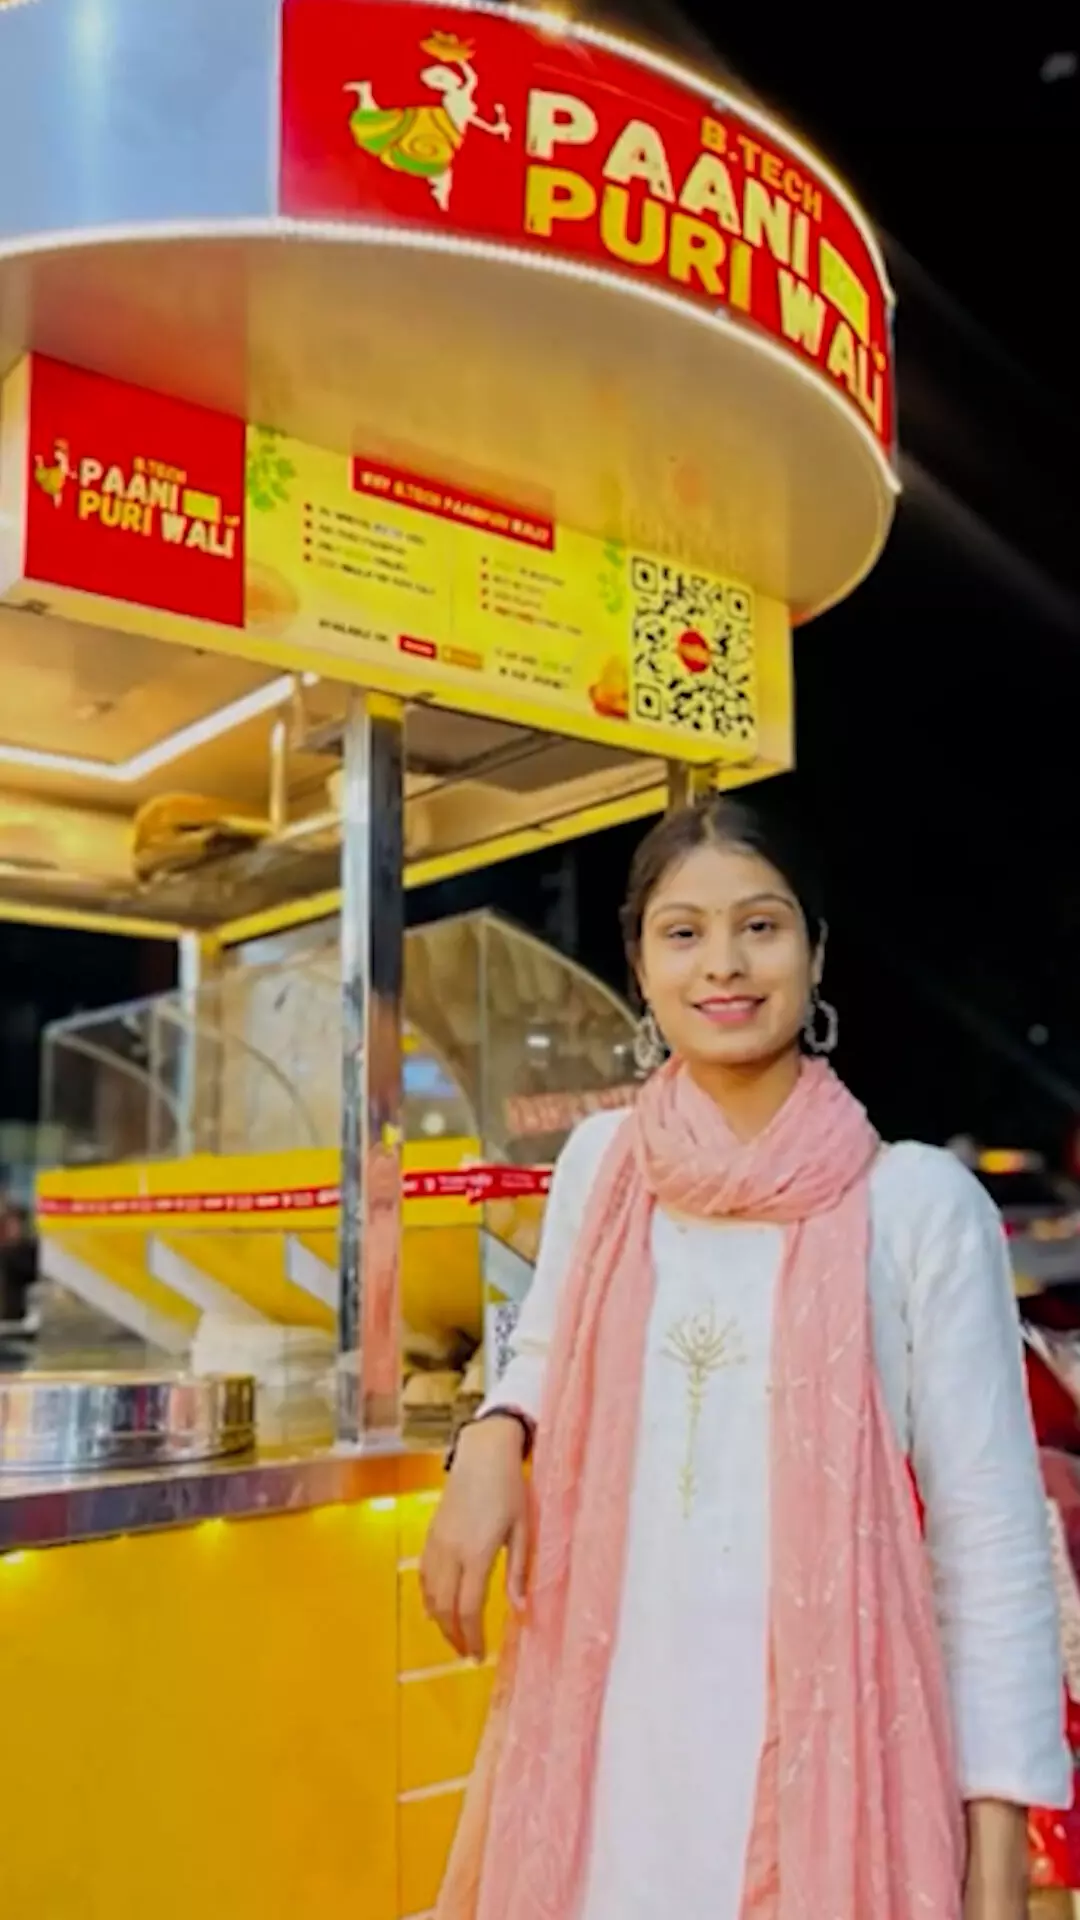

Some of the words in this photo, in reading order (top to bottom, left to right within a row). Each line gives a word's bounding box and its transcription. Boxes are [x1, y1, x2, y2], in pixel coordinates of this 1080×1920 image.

[525, 87, 810, 280] PAANI
[701, 116, 822, 223] B.TECH
[523, 164, 753, 312] PURI
[776, 266, 883, 435] WALI
[77, 489, 153, 536] PURI
[161, 511, 235, 560] WALI
[79, 456, 179, 513] PAANI
